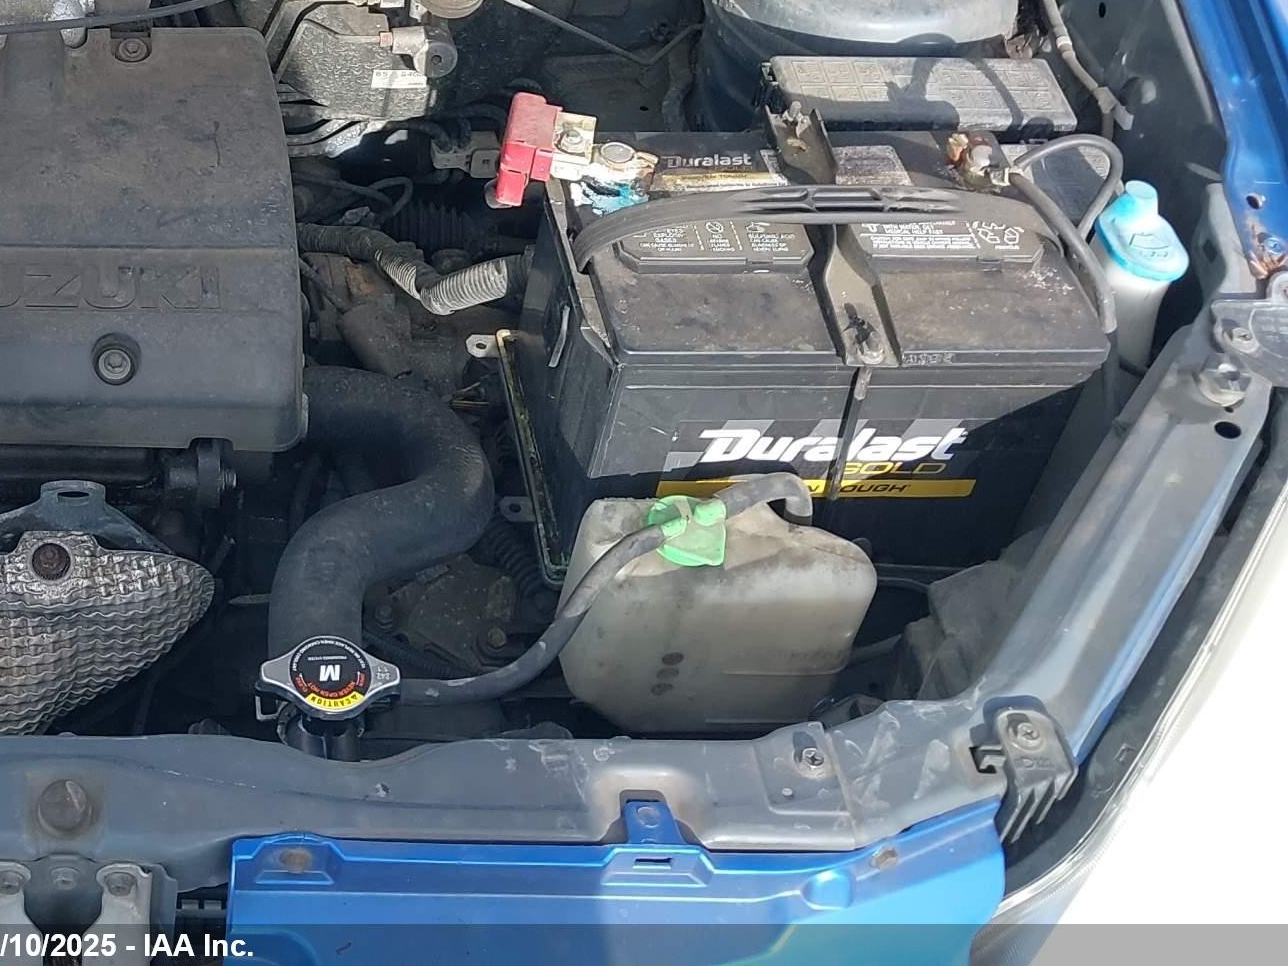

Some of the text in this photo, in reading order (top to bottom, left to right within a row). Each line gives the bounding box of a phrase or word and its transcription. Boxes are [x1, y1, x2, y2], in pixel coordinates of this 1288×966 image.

[661, 153, 753, 168] Duralast
[699, 426, 969, 463] Duralast
[319, 664, 341, 682] M
[310, 695, 351, 707] CAUTION
